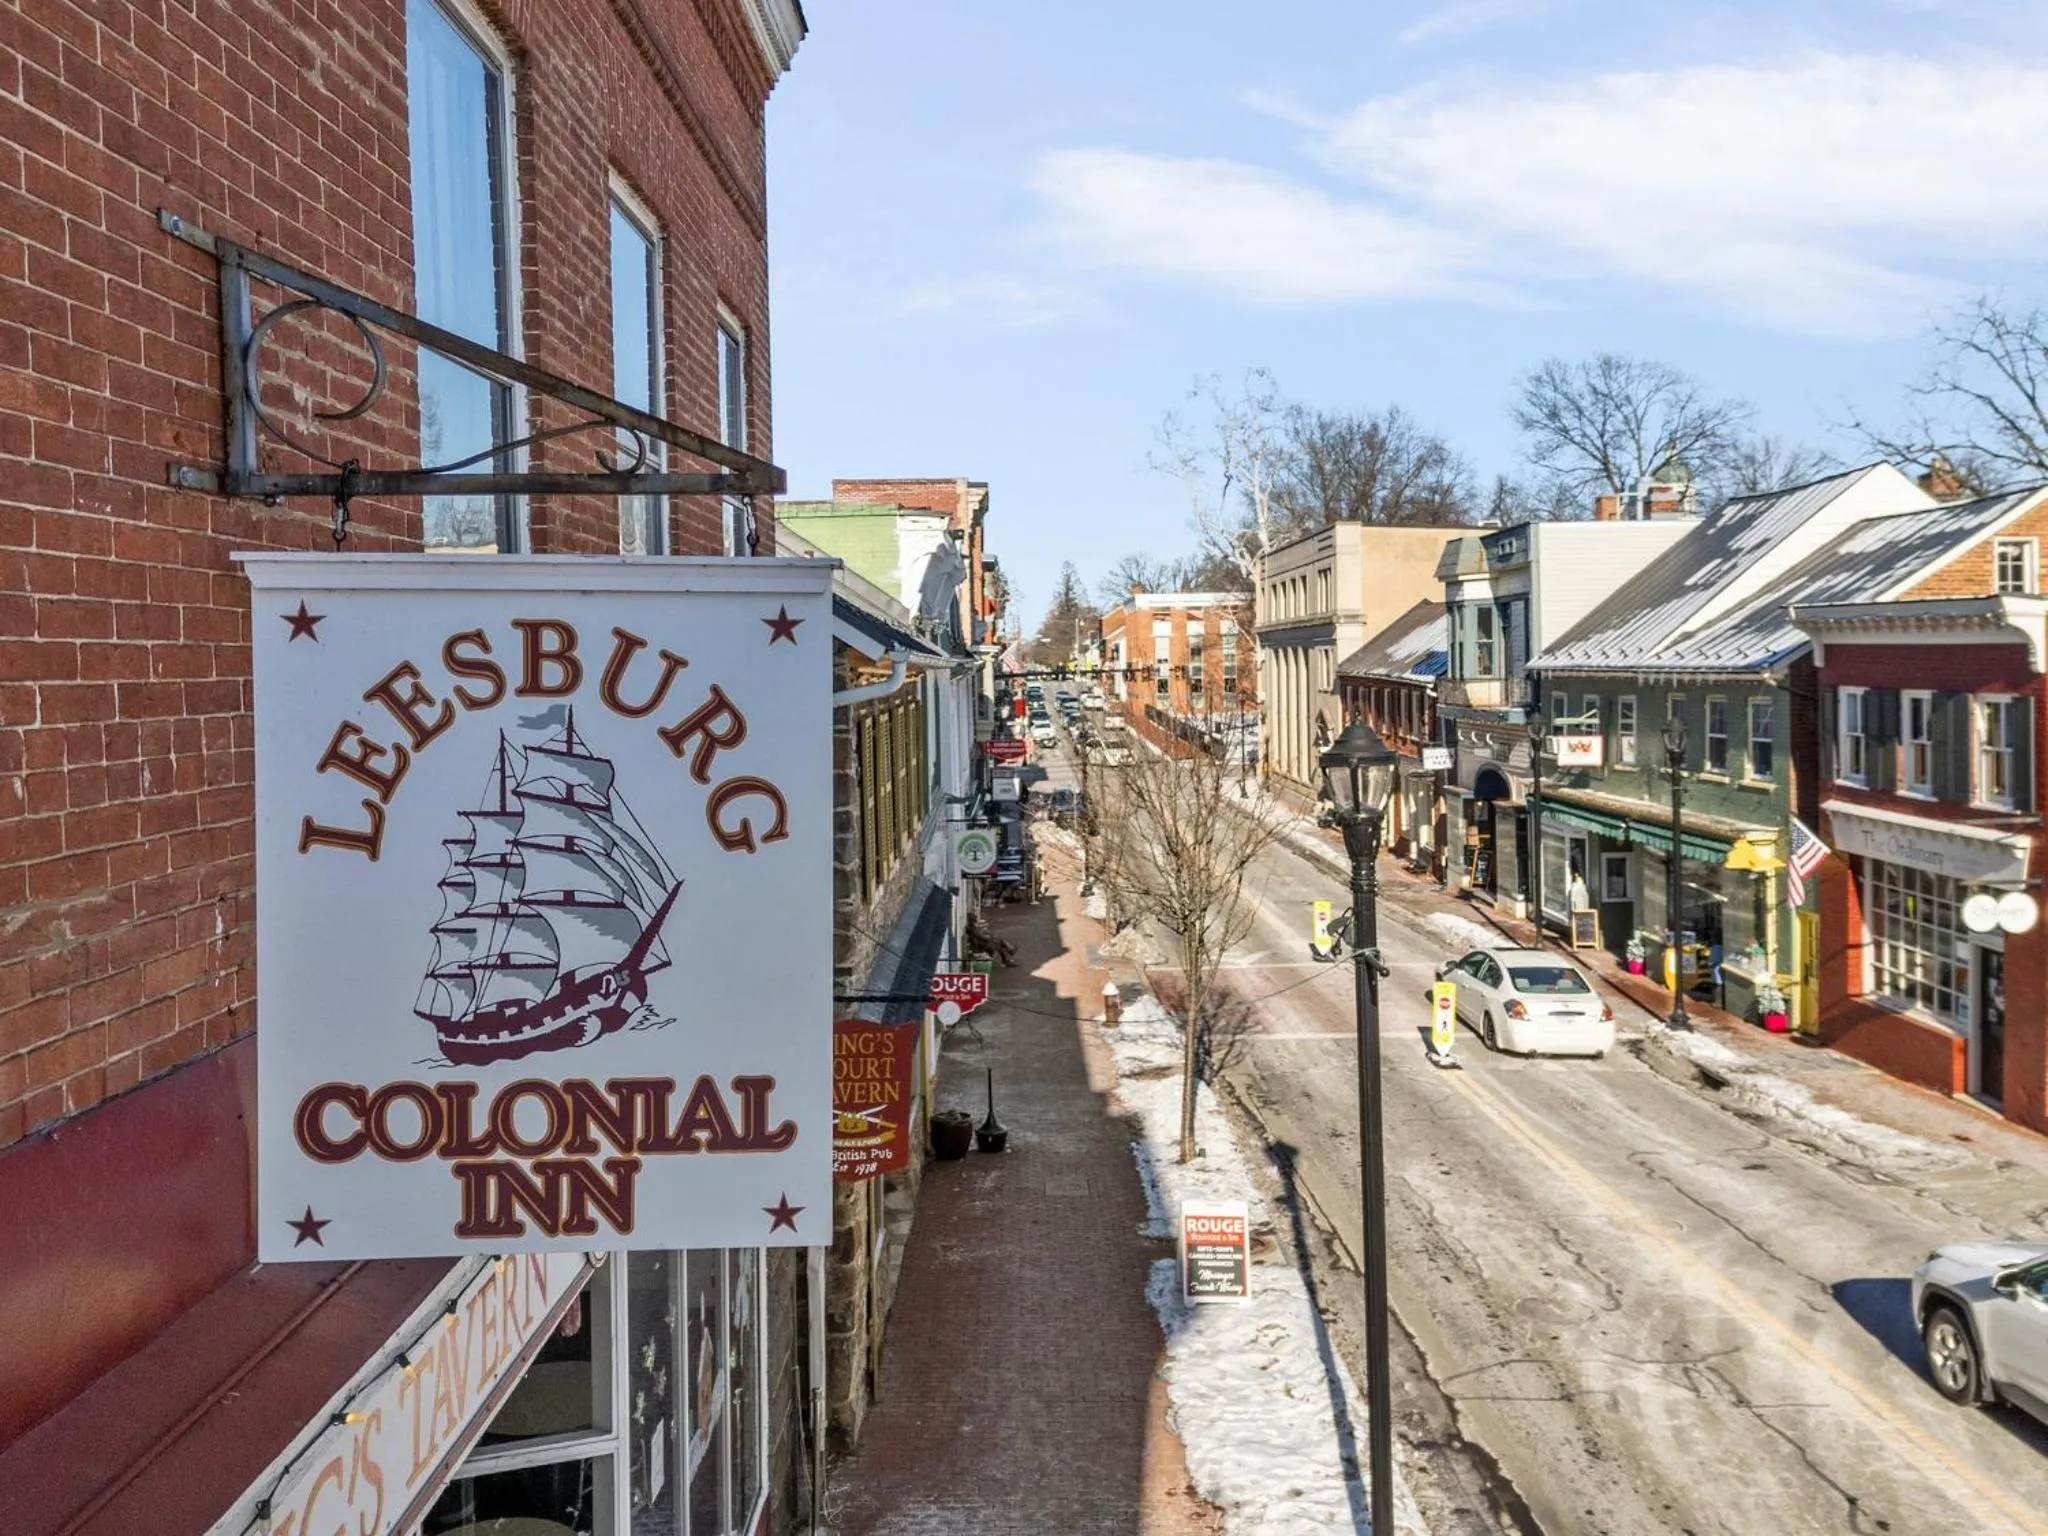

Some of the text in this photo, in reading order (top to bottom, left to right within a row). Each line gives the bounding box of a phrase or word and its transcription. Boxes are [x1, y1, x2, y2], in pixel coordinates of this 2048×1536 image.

[299, 617, 790, 863] LEESBURG
[930, 976, 982, 992] OUGE
[833, 1032, 894, 1055] ING'S
[833, 1057, 897, 1079] OURT
[833, 1080, 901, 1105] VERN
[293, 1074, 798, 1164] COLONIAL
[871, 1148, 893, 1159] Pub
[454, 1156, 643, 1240] INN
[1186, 1217, 1244, 1234] ROUGE
[397, 1253, 549, 1490] TAVERN
